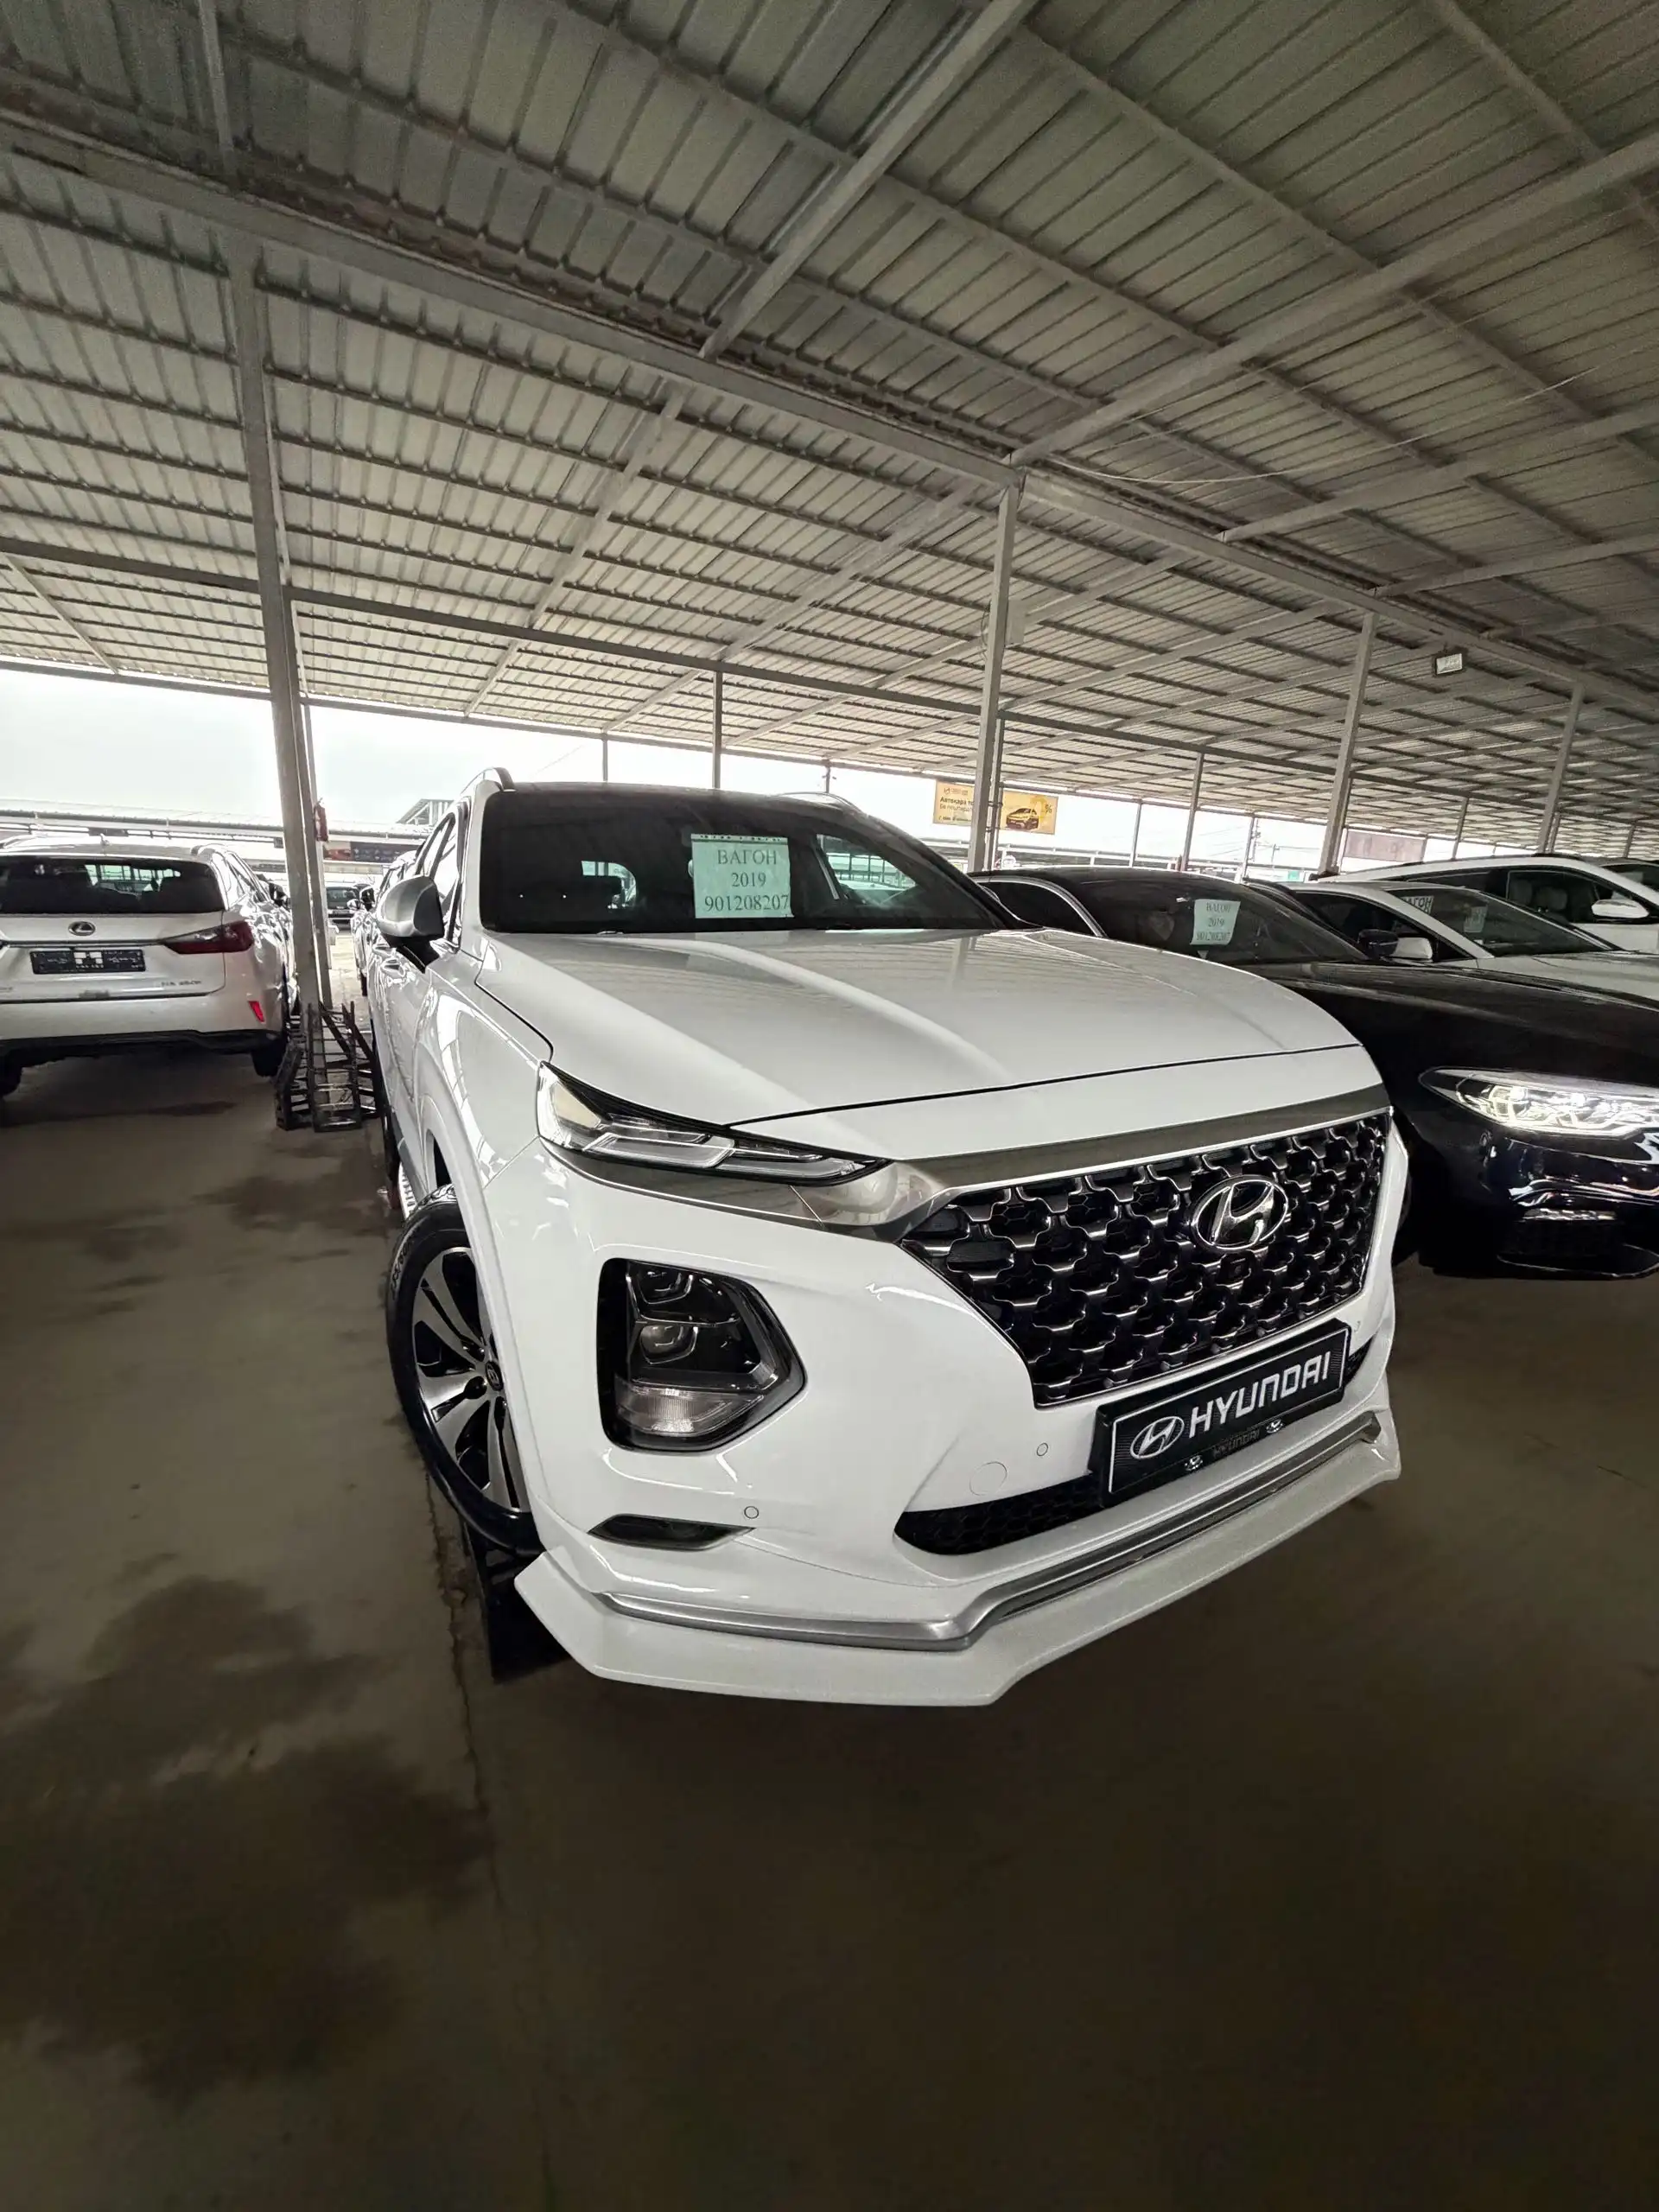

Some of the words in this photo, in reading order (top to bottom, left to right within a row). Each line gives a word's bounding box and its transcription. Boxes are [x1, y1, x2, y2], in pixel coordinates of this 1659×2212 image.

[717, 849, 777, 865] ВАГОН
[731, 872, 766, 887] 2019
[704, 893, 789, 912] 901208207
[1188, 1351, 1331, 1438] HYUNDAI
